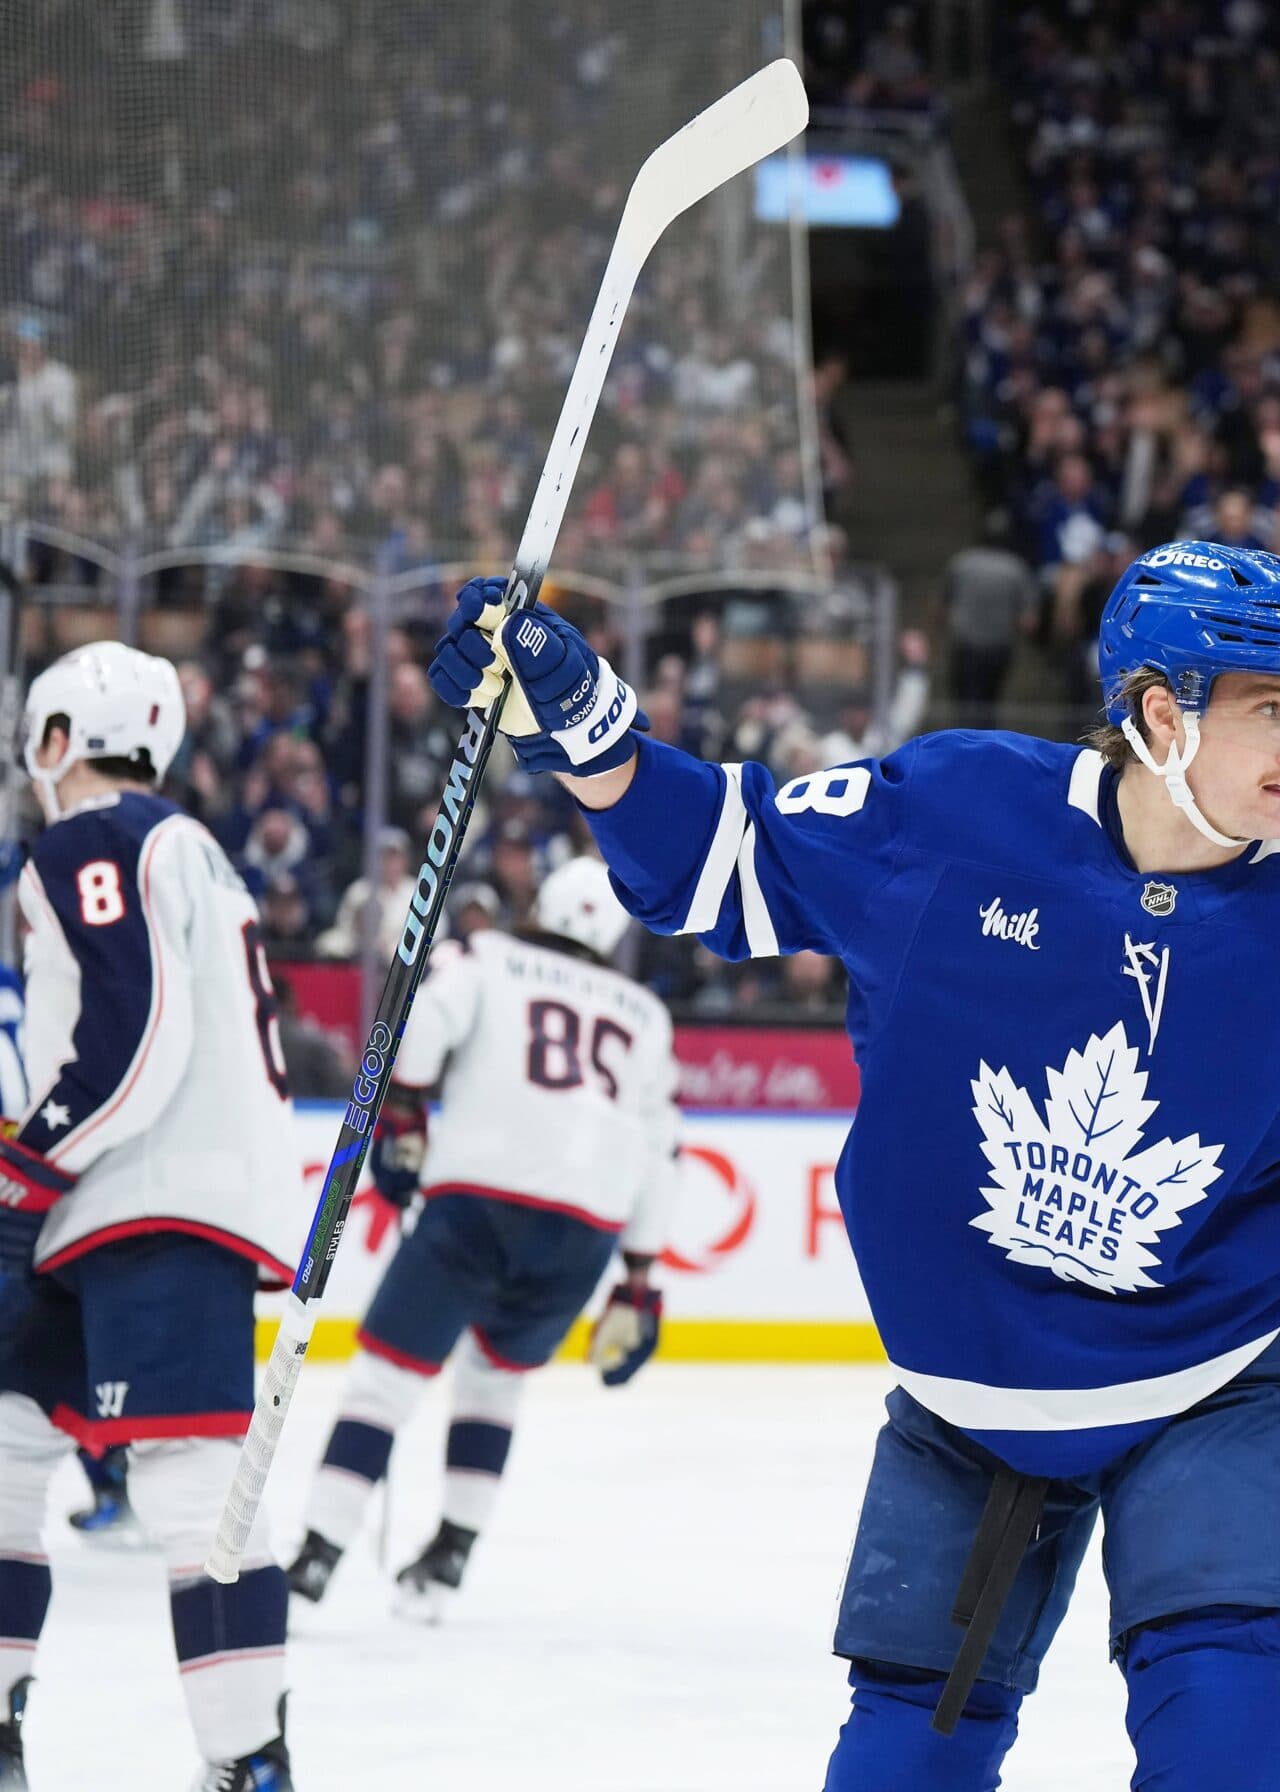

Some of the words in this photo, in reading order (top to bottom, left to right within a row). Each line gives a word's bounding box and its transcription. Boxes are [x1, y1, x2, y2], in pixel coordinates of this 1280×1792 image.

[1148, 550, 1225, 572] OREO
[77, 859, 126, 927] 8
[1148, 894, 1171, 906] NHL
[979, 897, 1041, 950] Milk
[527, 997, 633, 1103] 85
[1004, 1142, 1159, 1220] TORONTO
[1022, 1173, 1127, 1235] MAPLE
[326, 1220, 346, 1261] STYLES
[1016, 1201, 1120, 1261] LEAFS
[301, 1256, 314, 1284] PRO
